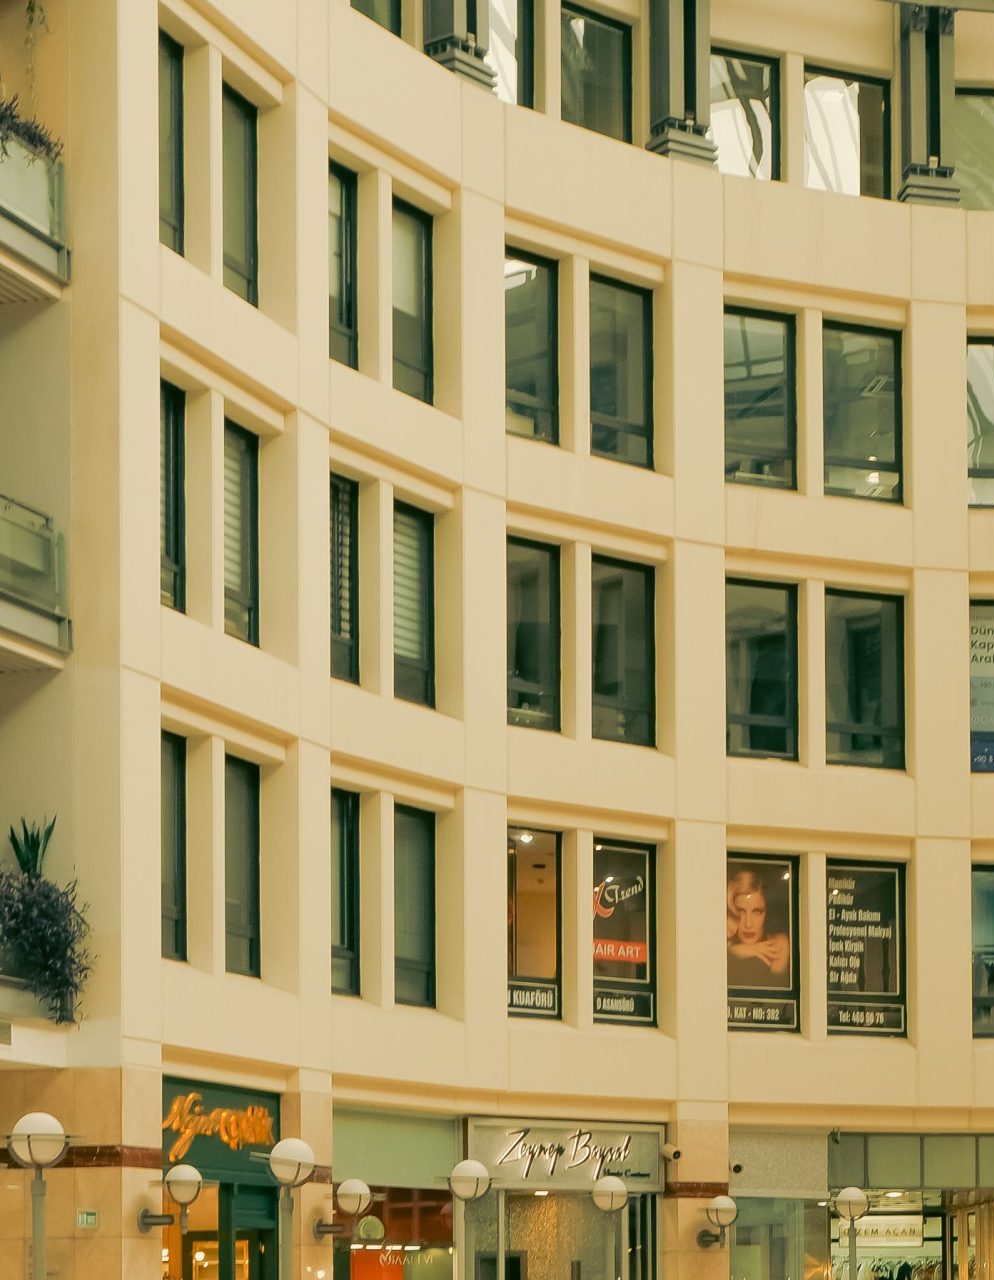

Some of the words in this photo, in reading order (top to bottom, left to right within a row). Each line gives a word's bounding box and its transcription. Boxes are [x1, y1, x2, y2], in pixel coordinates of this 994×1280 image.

[605, 875, 643, 904] Trend
[828, 908, 835, 921] El
[841, 909, 857, 922] Ayak
[858, 909, 880, 922] Bakımı
[828, 924, 867, 938] Profesyonel
[868, 925, 891, 939] Makyaj
[618, 945, 640, 958] ART
[513, 988, 553, 1008] KUAFÖRÜ
[734, 1006, 746, 1019] KAT
[752, 1007, 765, 1020] NO:
[838, 1010, 850, 1022] Tel:
[497, 1128, 565, 1179] Zeynep
[565, 1128, 632, 1181] Baysal
